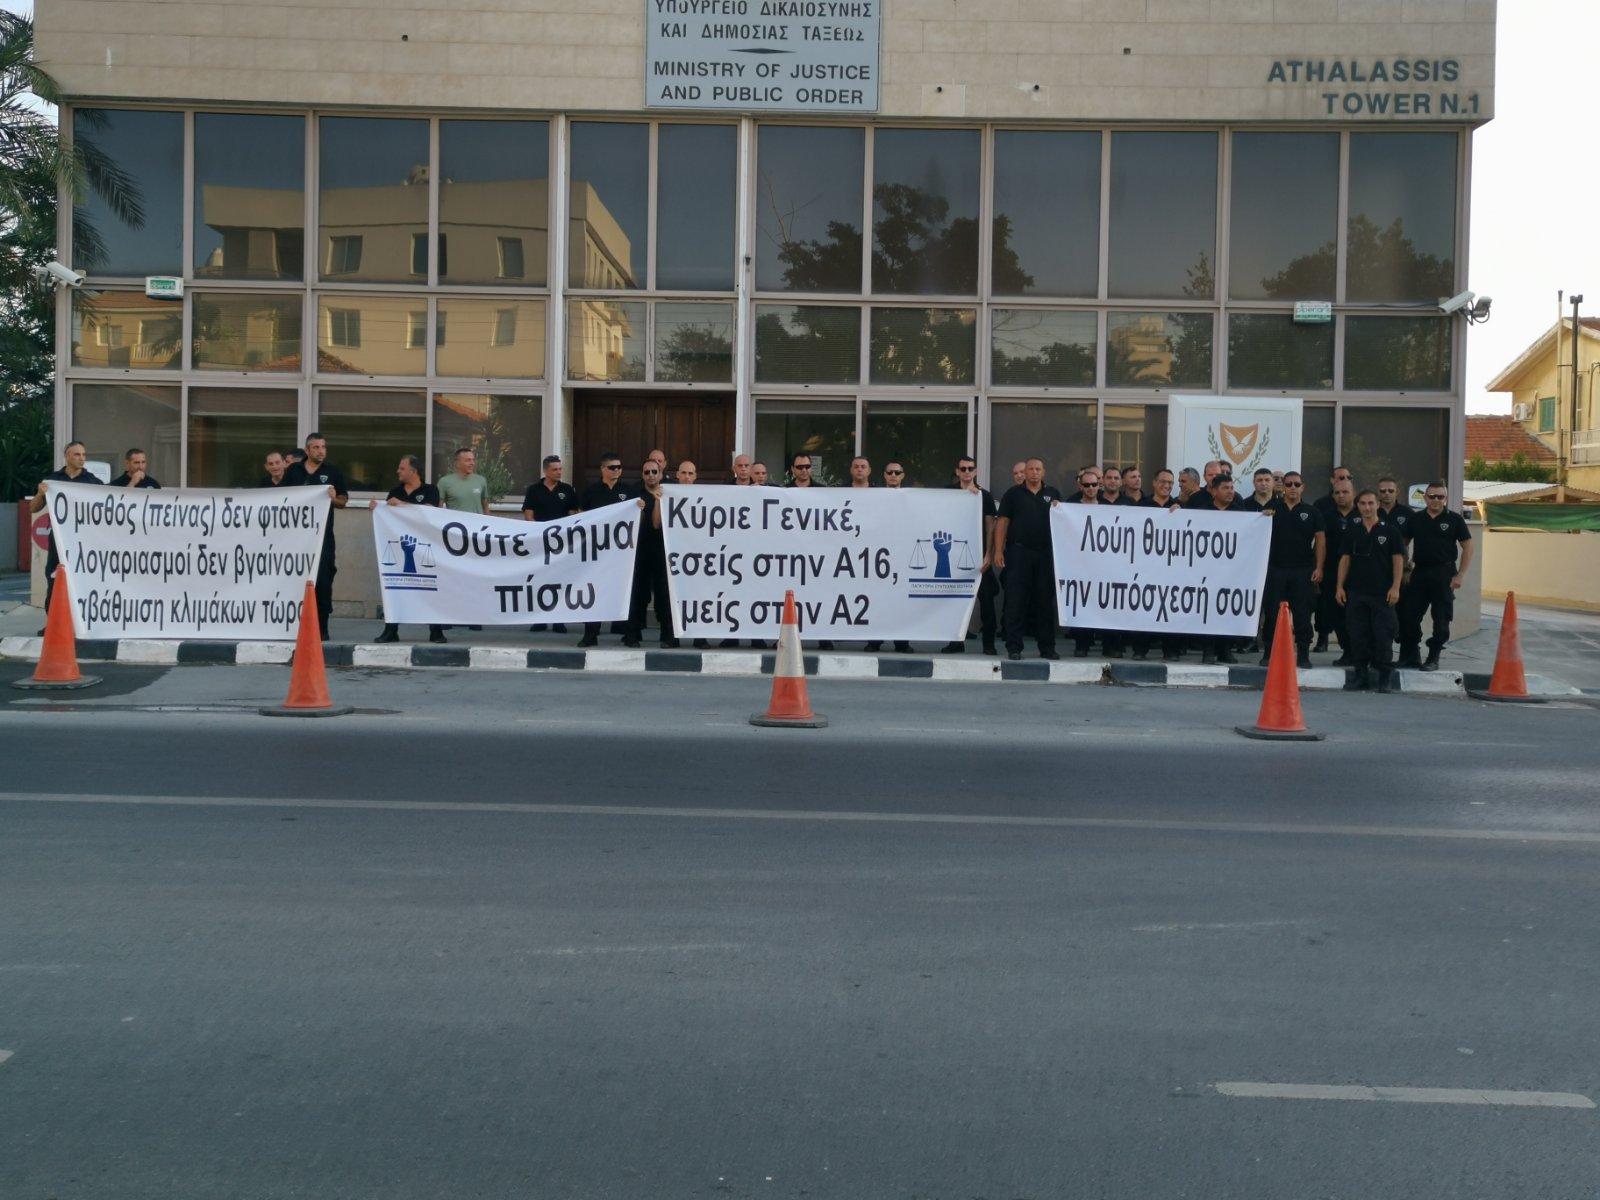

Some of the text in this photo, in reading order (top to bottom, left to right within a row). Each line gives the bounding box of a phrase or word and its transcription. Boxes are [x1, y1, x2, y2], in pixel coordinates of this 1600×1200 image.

[760, 1, 871, 17] ΔΙΚΑΙΟΣΥΝΗΣ
[662, 23, 864, 41] ΚΑΙ ΔΗΜΟΣΙΑΣ ΤΑΞΕΩΣ
[655, 61, 870, 79] MINISTRY OF JUSTICE
[1268, 60, 1459, 82] ATHALASSIS
[661, 85, 862, 104] AND PUBLIC ORDER
[1322, 93, 1478, 114] TOWER N.1
[55, 492, 319, 536] Ο μισθός (πείνας) δεν φτάνει,
[669, 497, 860, 537] Κύριε Γενικέ,
[442, 517, 634, 565] Ούτε βήμα
[1081, 515, 1237, 567] Λούη θυμήσου
[75, 542, 315, 584] λογαριασμοί δεν βγαίνουν
[668, 545, 897, 585] εσείς στην Α16,
[171, 591, 256, 631] κλιμάκων
[494, 574, 595, 612] πίσω
[682, 592, 740, 632] μείς
[830, 594, 869, 625] Α2
[1099, 573, 1208, 624] υπόσχεσή
[1216, 588, 1256, 616] σου
